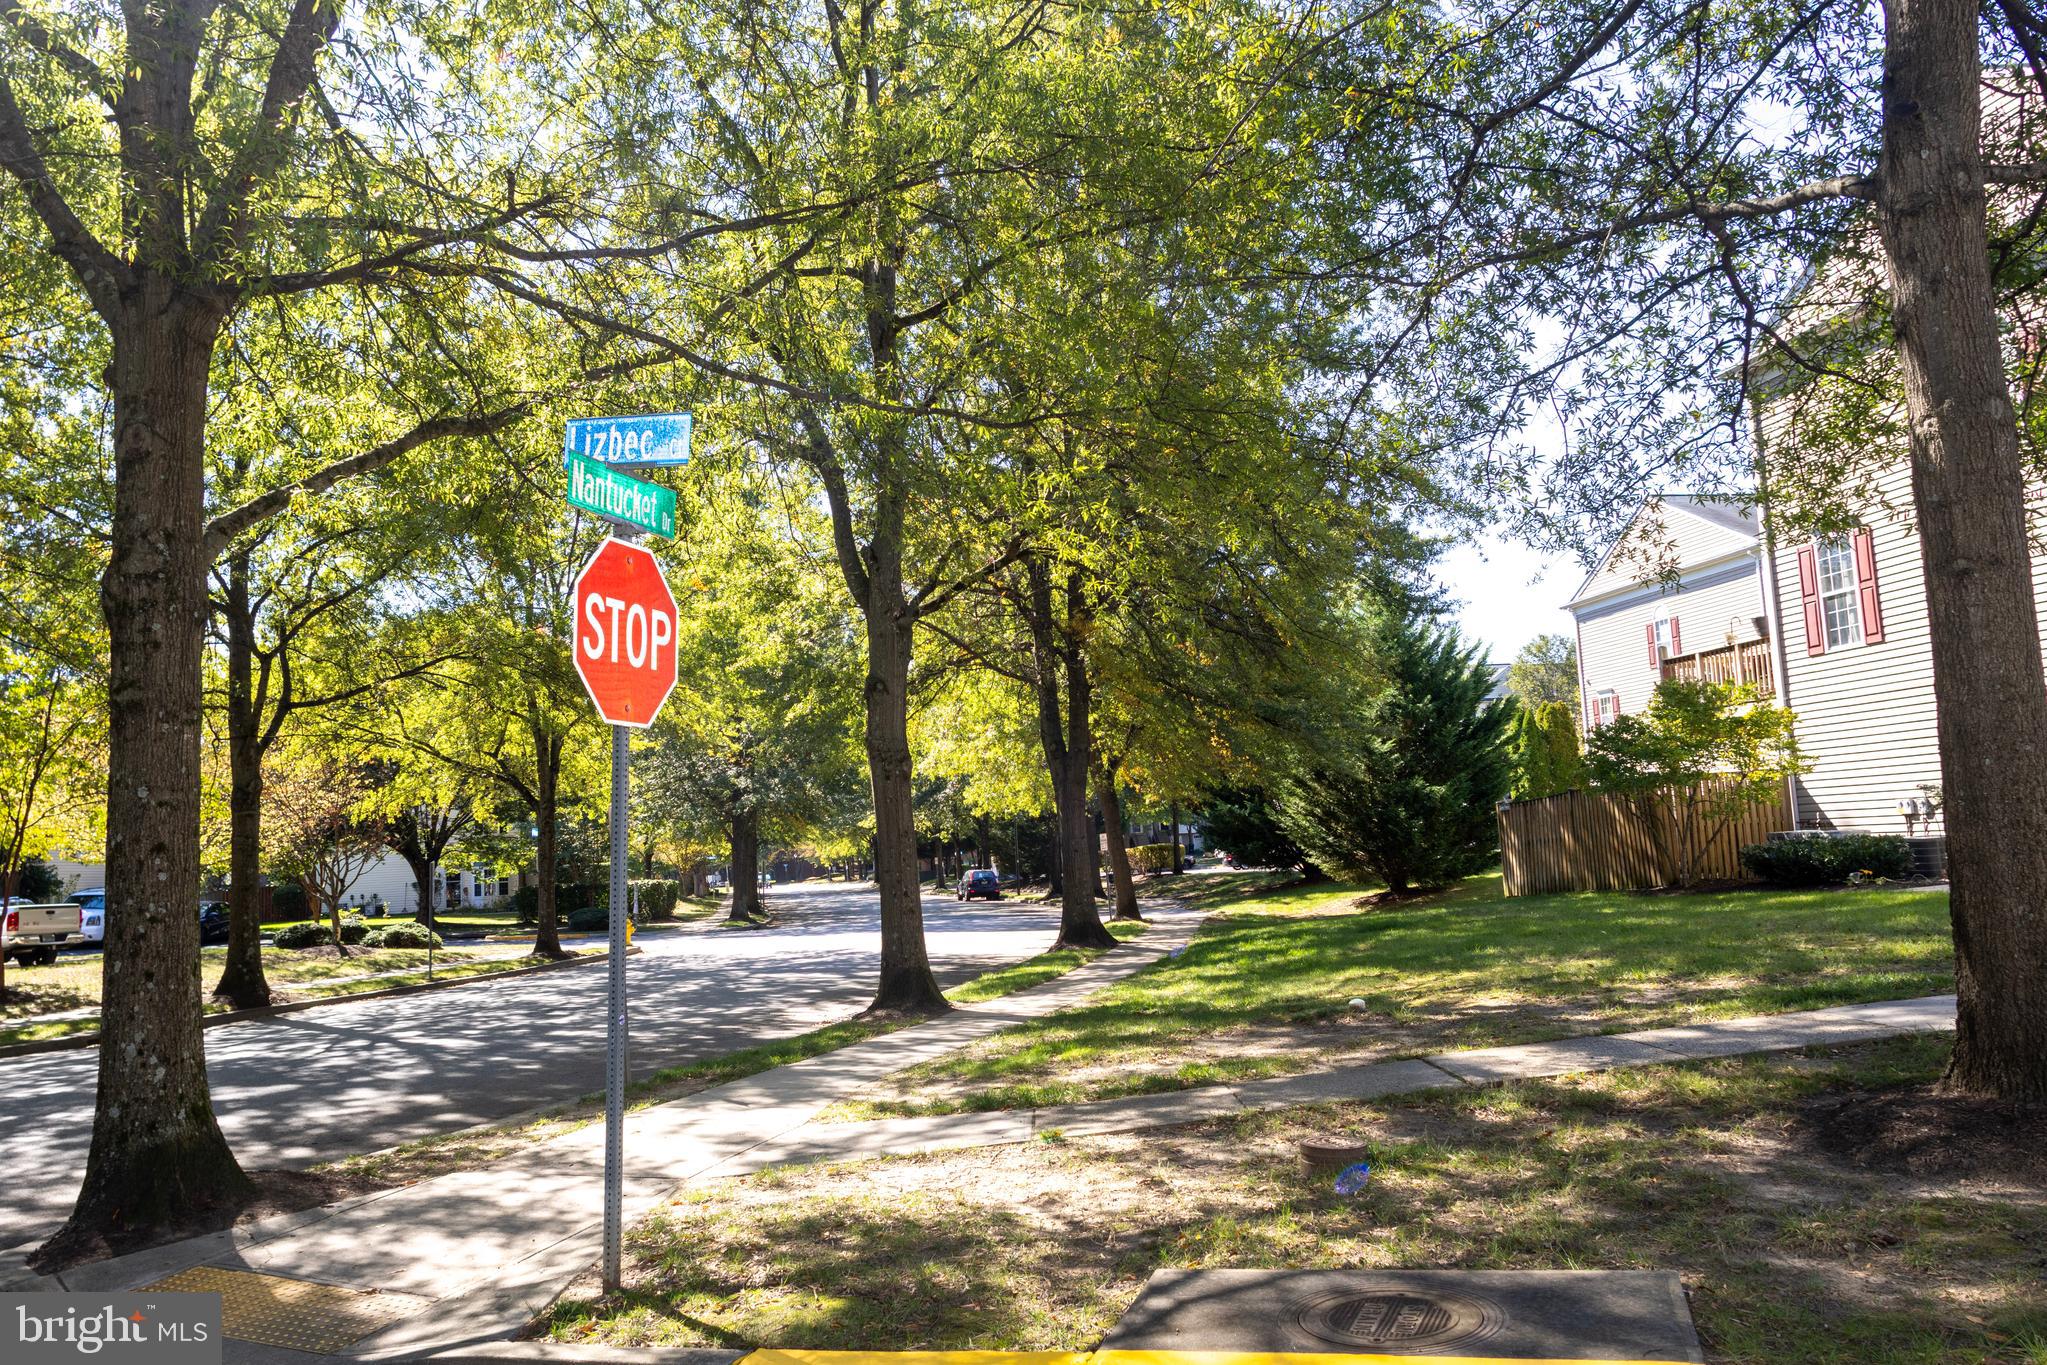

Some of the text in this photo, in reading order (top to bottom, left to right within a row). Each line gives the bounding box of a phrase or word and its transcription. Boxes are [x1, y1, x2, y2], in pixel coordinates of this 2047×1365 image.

[571, 459, 671, 532] Nantucket Dr
[582, 592, 672, 671] STOP
[1354, 1303, 1385, 1332] DRAIN
